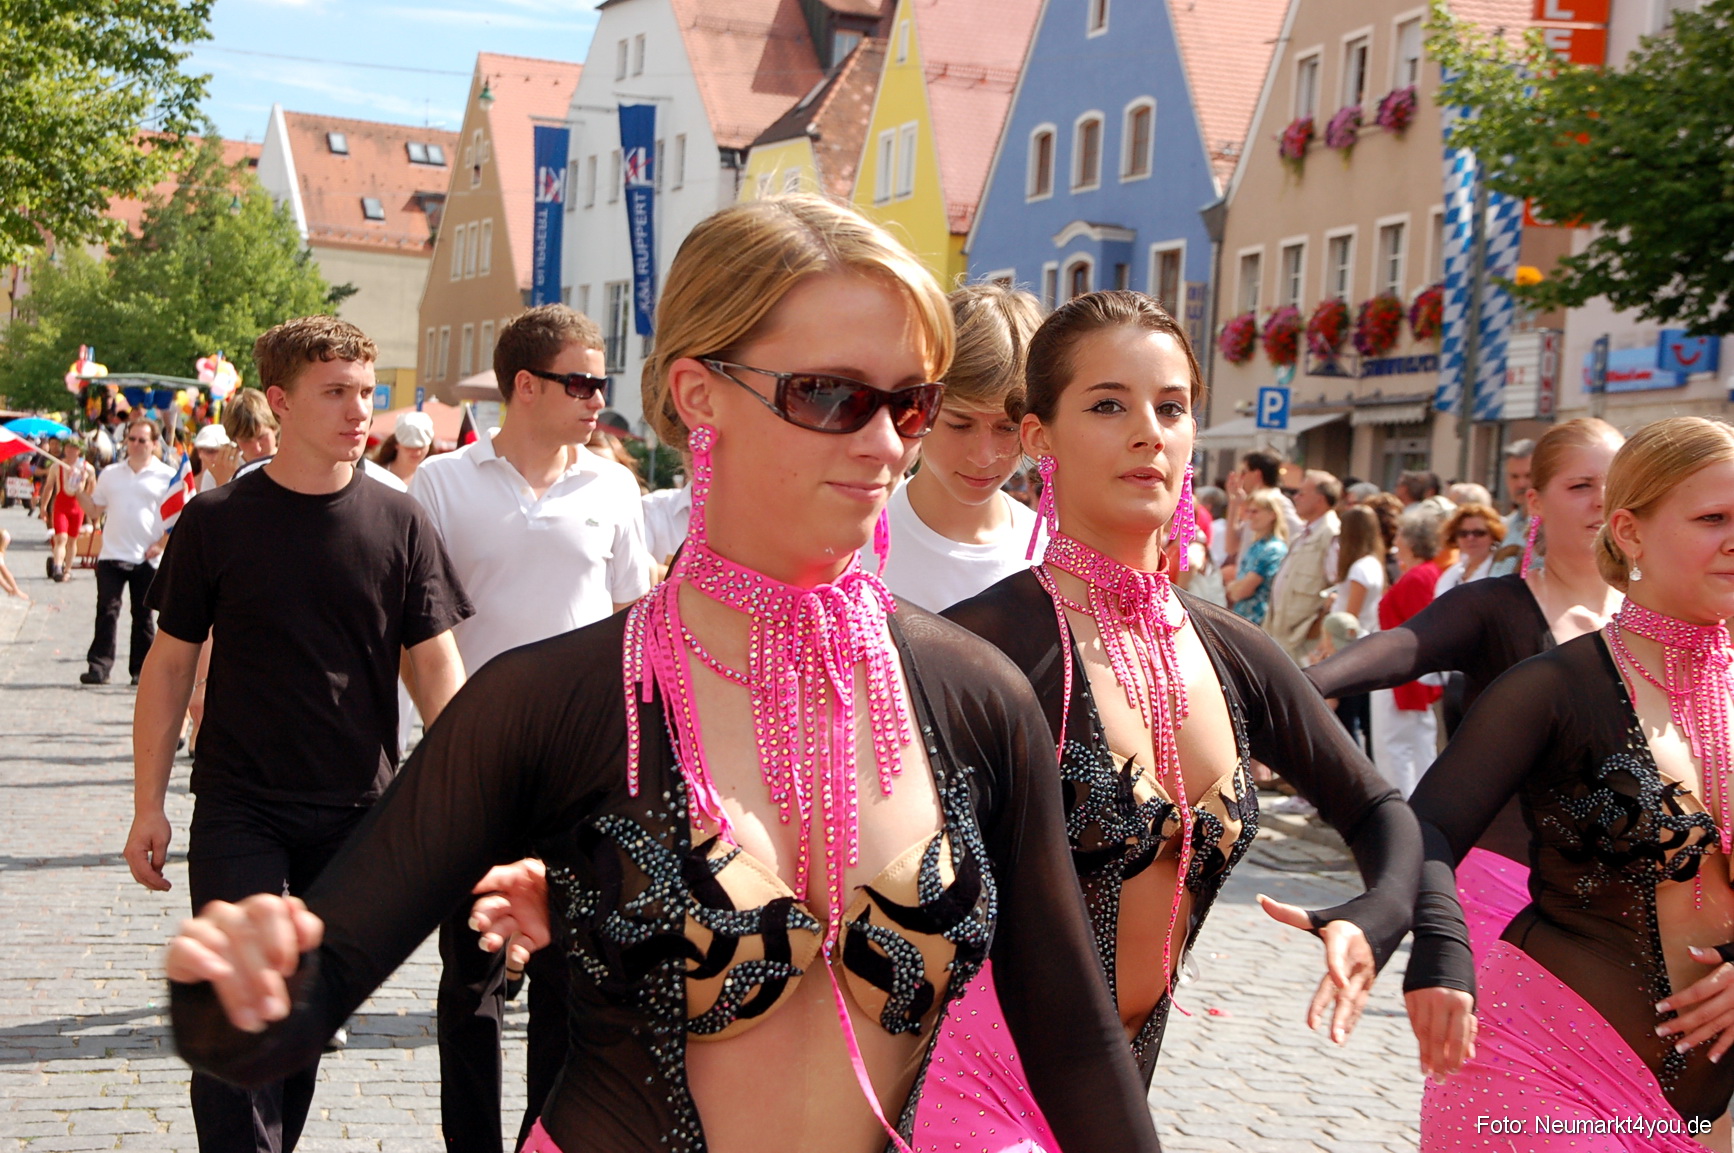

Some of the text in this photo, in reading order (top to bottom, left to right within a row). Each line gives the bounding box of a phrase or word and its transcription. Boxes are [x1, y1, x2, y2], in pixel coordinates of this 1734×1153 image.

[634, 191, 649, 276] RUPPERT
[1262, 390, 1284, 424] P
[1540, 334, 1558, 414] KINO
